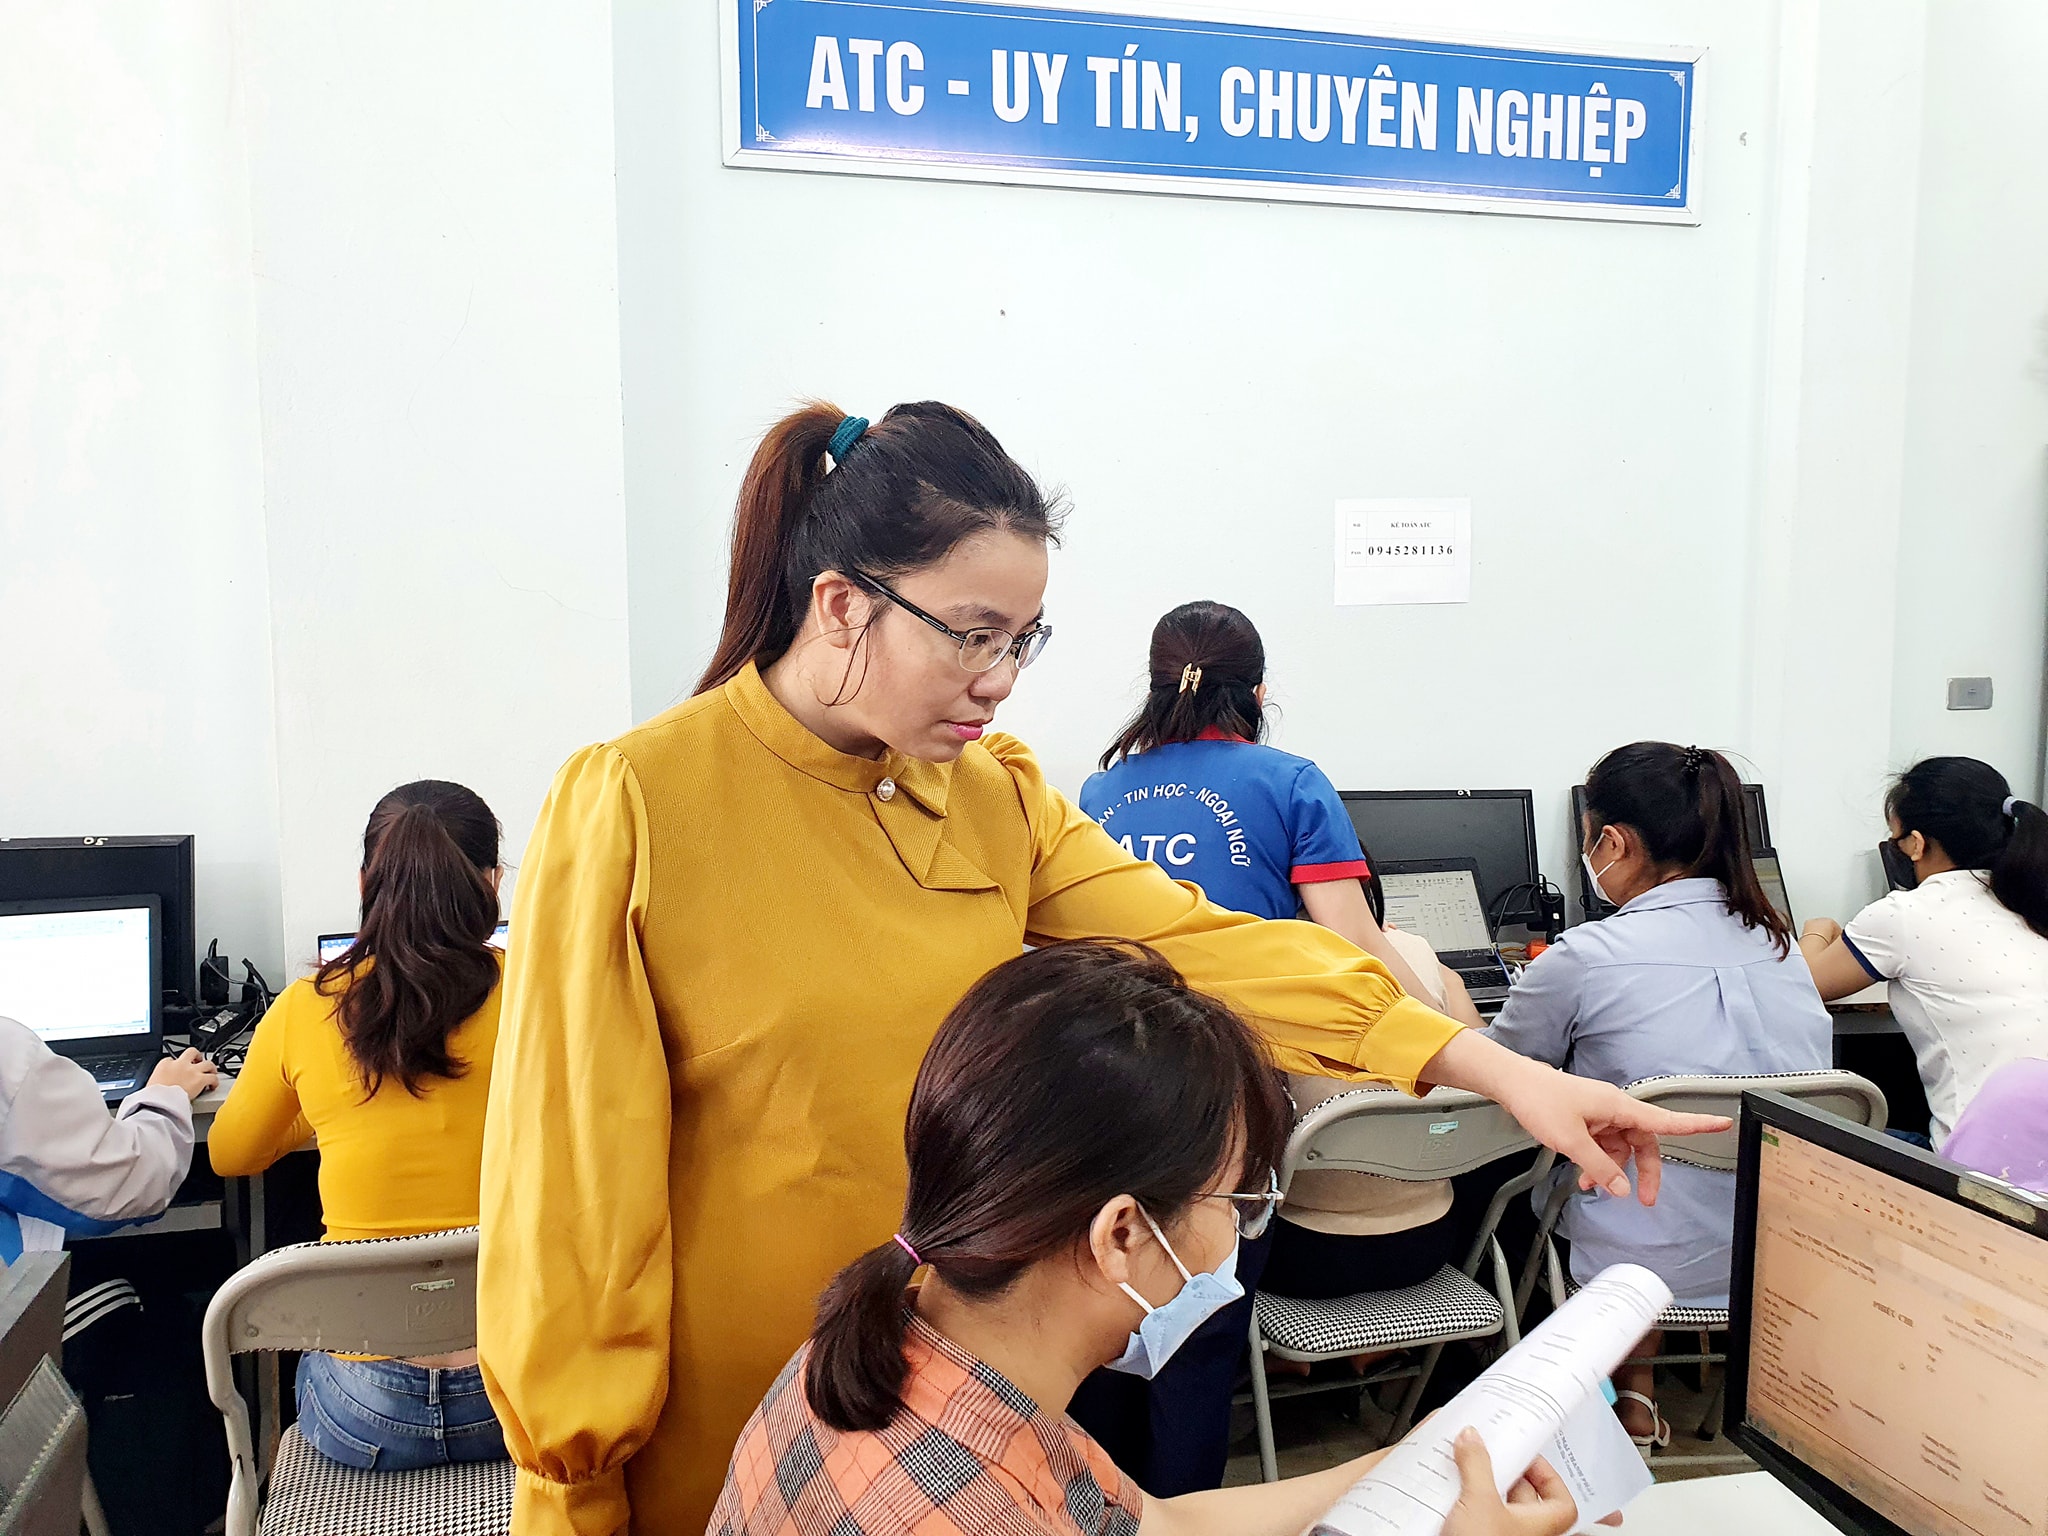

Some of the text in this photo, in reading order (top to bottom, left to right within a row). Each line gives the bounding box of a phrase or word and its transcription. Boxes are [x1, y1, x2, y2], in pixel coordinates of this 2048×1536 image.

[805, 36, 1647, 177] ATC - UY TÍN, CHUYÊN NGHIỆP
[1401, 520, 1418, 528] TOÁN
[1368, 545, 1453, 555] 0945281136
[1124, 787, 1148, 804] TIN
[1152, 783, 1187, 800] HỌC
[1195, 787, 1238, 828] NGOẠI
[1226, 827, 1252, 868] NGỮ
[1119, 834, 1196, 866] ATC
